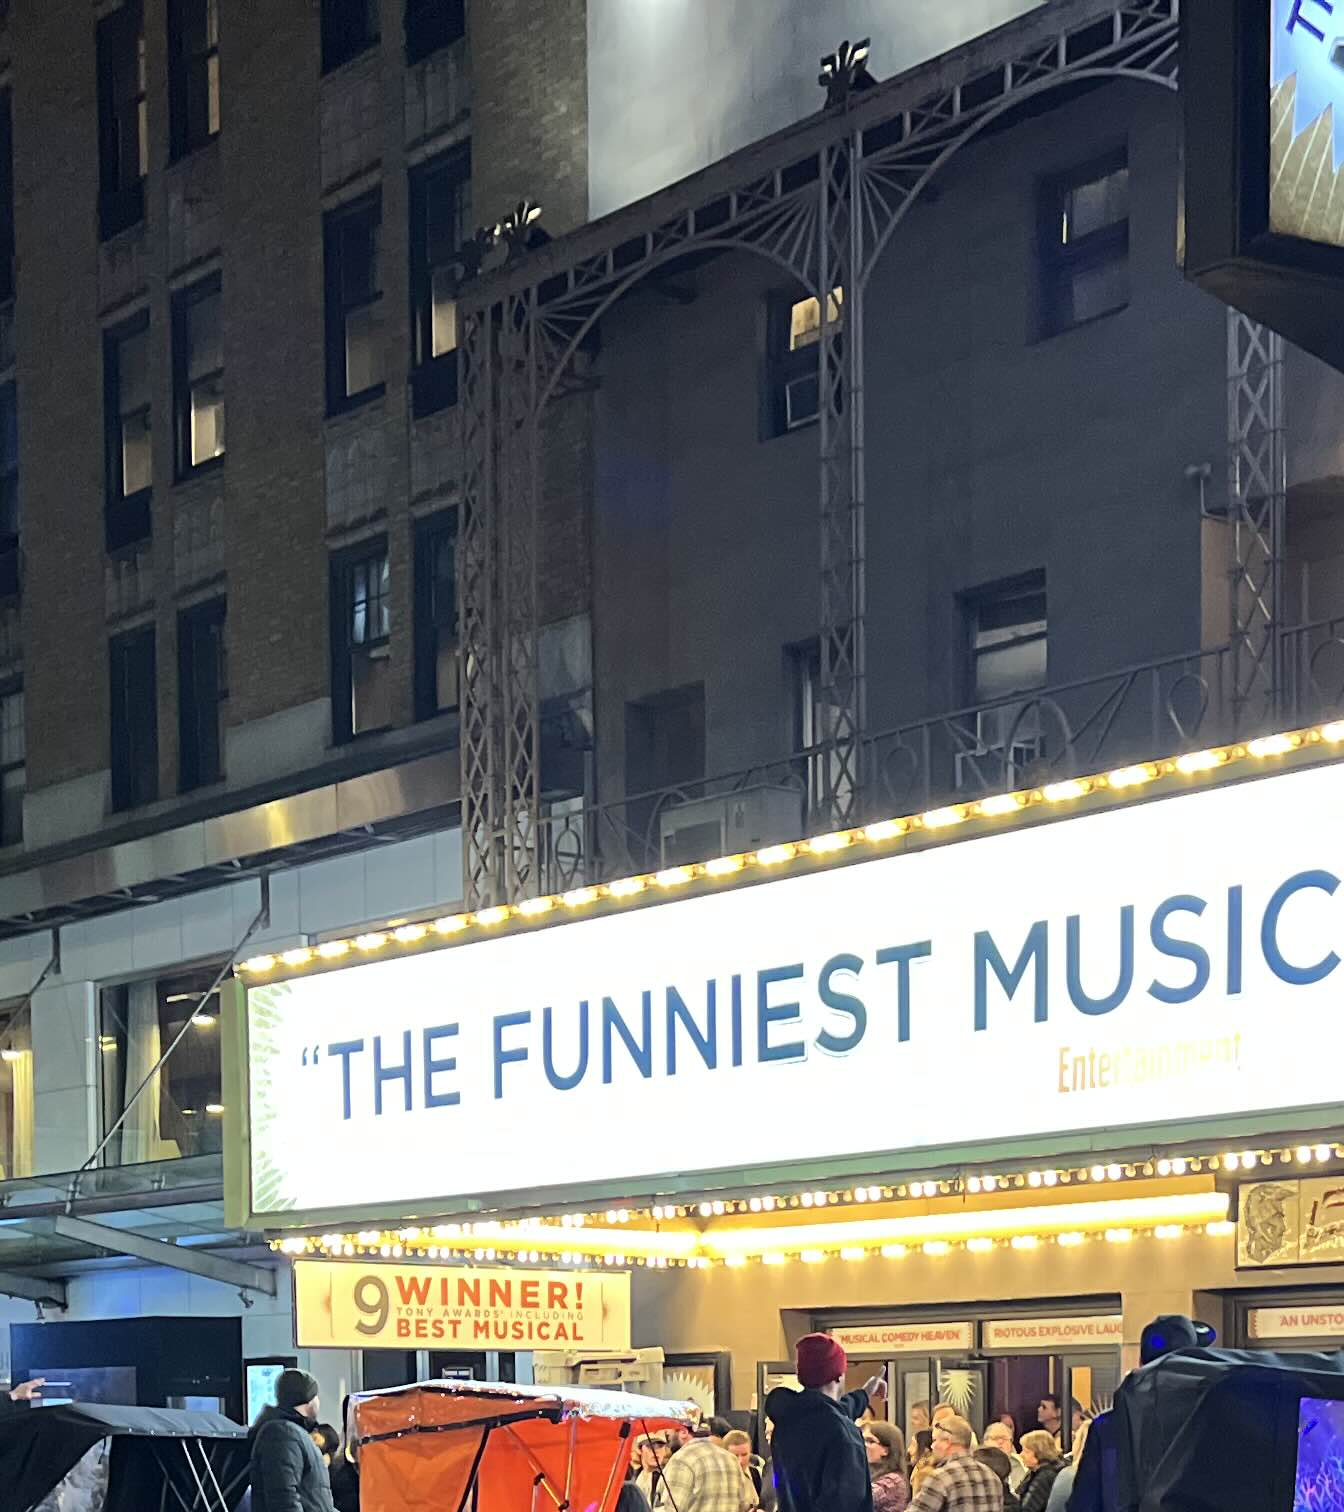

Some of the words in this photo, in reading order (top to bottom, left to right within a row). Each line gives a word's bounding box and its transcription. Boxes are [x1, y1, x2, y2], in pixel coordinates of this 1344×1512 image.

[492, 940, 933, 1101] FUNNIEST
[354, 1274, 390, 1335] 9
[394, 1275, 584, 1310] WINNER!
[396, 1306, 434, 1317] TONY
[397, 1318, 462, 1339] BEST
[473, 1319, 584, 1341] MUSICAL
[881, 1330, 919, 1343] COMEDY
